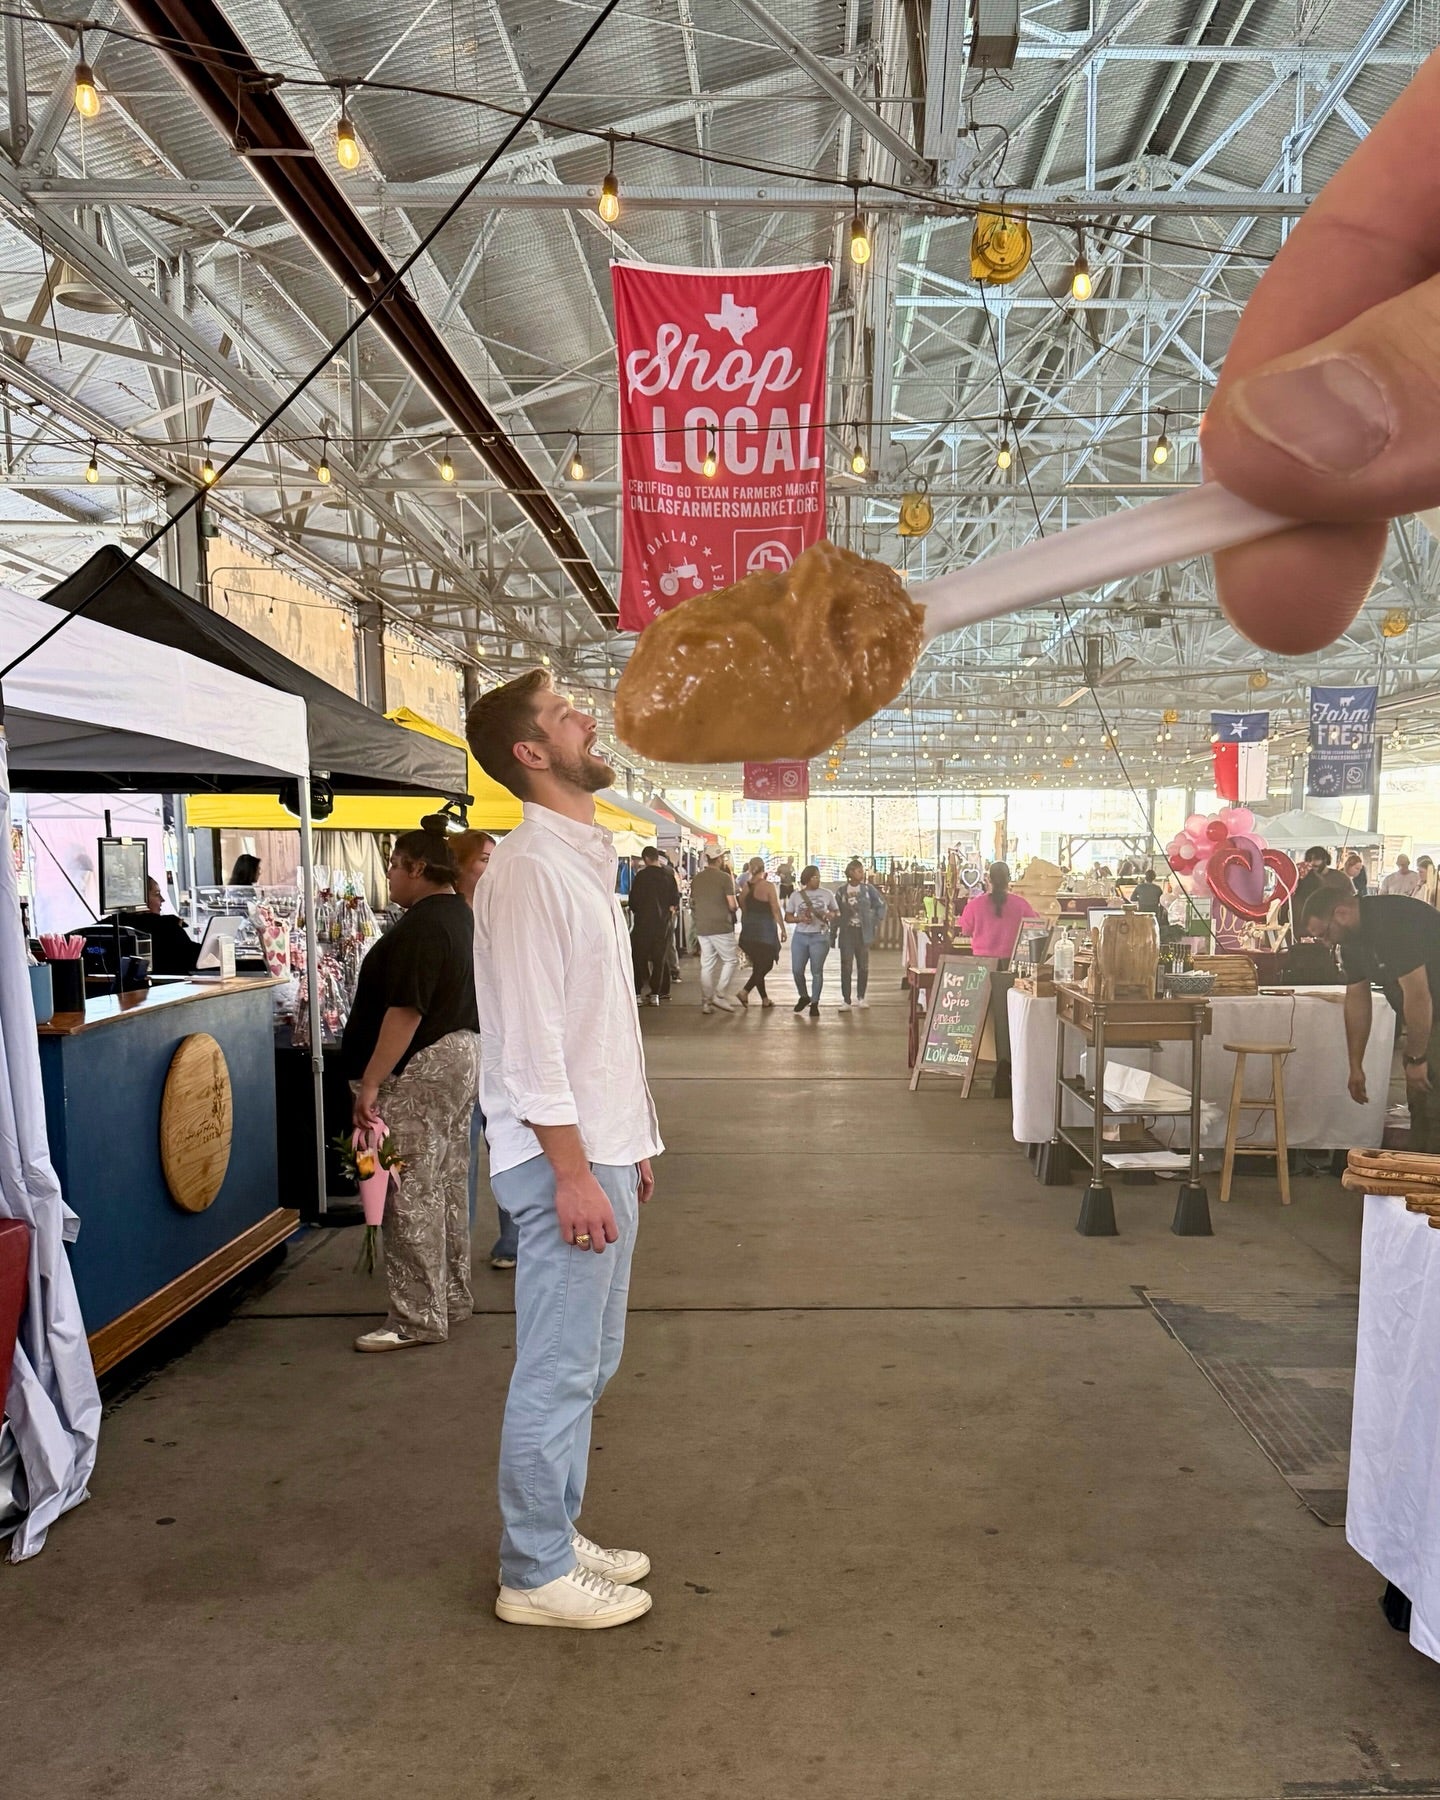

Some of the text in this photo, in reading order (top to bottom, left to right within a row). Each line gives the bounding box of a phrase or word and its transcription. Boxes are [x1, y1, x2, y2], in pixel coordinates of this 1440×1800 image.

[626, 323, 803, 405] Shop
[652, 403, 820, 476] LOCAL
[628, 479, 820, 499] CERTIFIED GO TEXAN FARMERS MARKET
[630, 495, 819, 518] DALLASFARMERSMARKET.ORG
[646, 529, 698, 555] DALLAS
[1311, 703, 1370, 724] Farm
[1317, 723, 1375, 745] FRESH
[942, 990, 970, 1011] Spice
[926, 1047, 949, 1062] LOW
